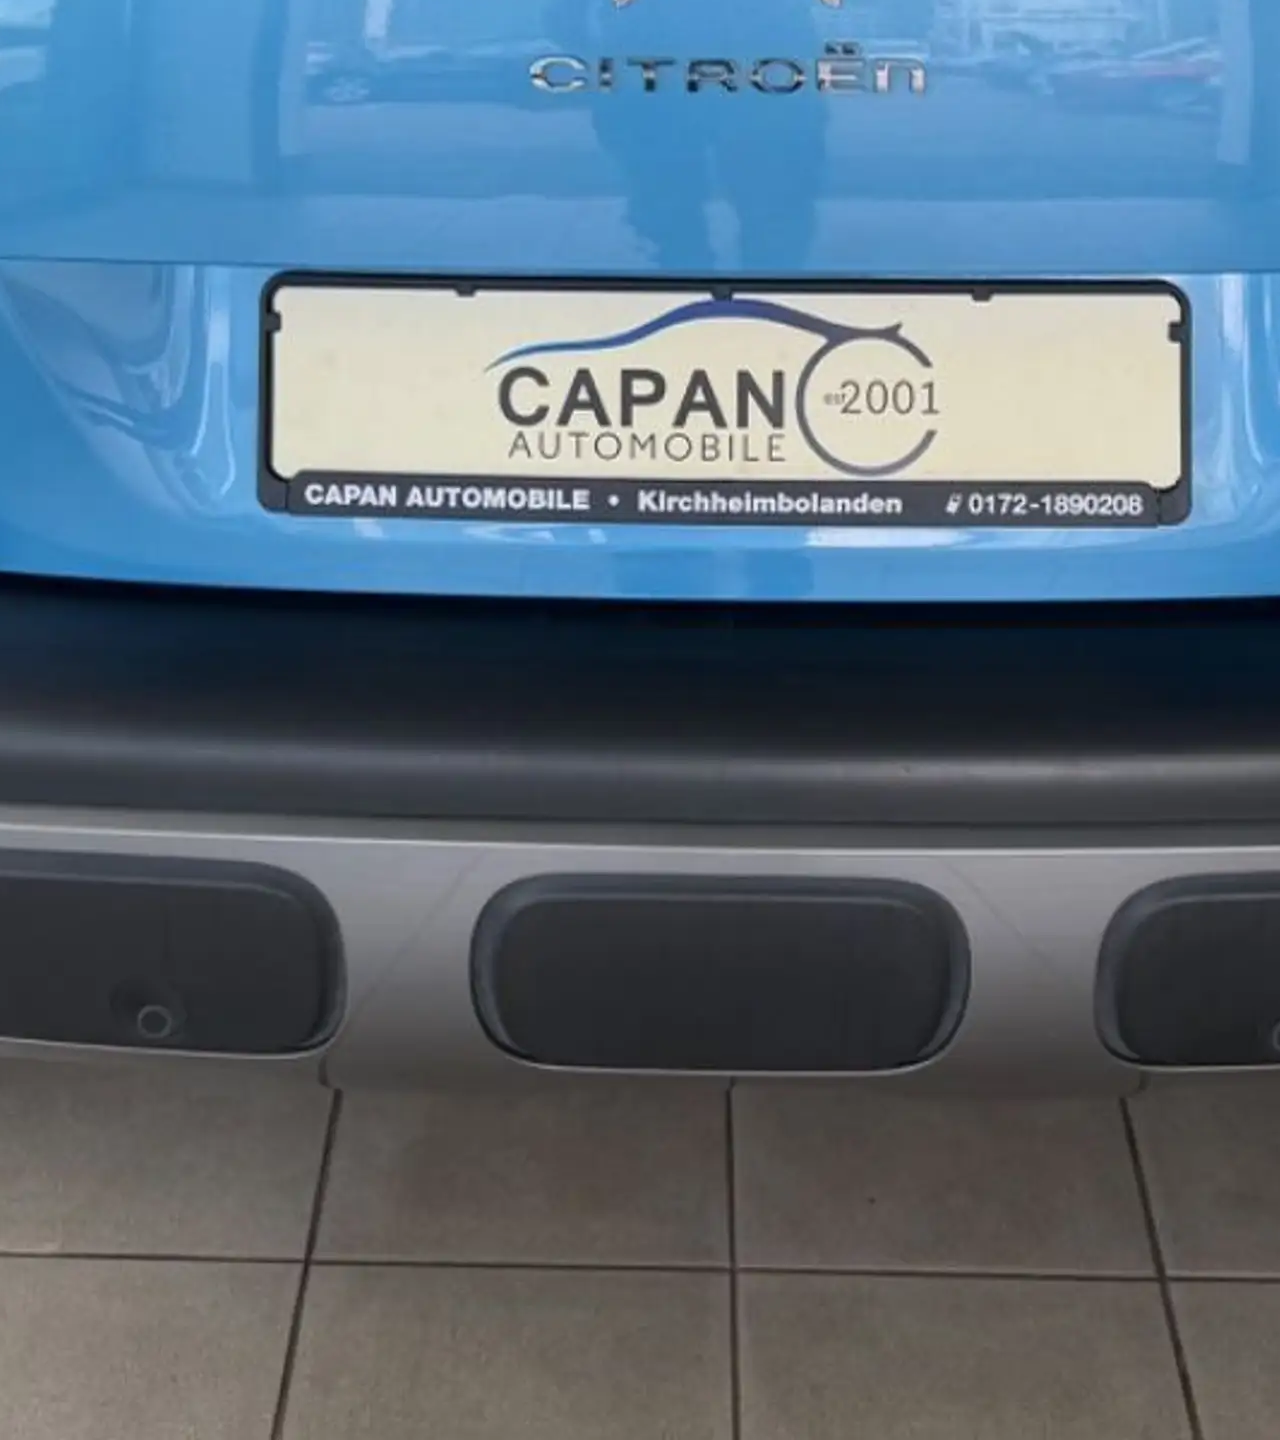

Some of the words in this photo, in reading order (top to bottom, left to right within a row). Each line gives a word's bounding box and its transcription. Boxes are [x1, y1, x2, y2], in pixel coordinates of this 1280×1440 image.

[498, 366, 785, 428] CAPAN
[840, 379, 940, 415] 2001
[508, 430, 787, 462] AUTOMOBILE
[303, 483, 398, 507] CAPAN
[406, 485, 591, 510] AUTOMOBILE
[637, 488, 904, 514] Kirchheimbolanden
[968, 492, 1145, 516] 0172-1890208
